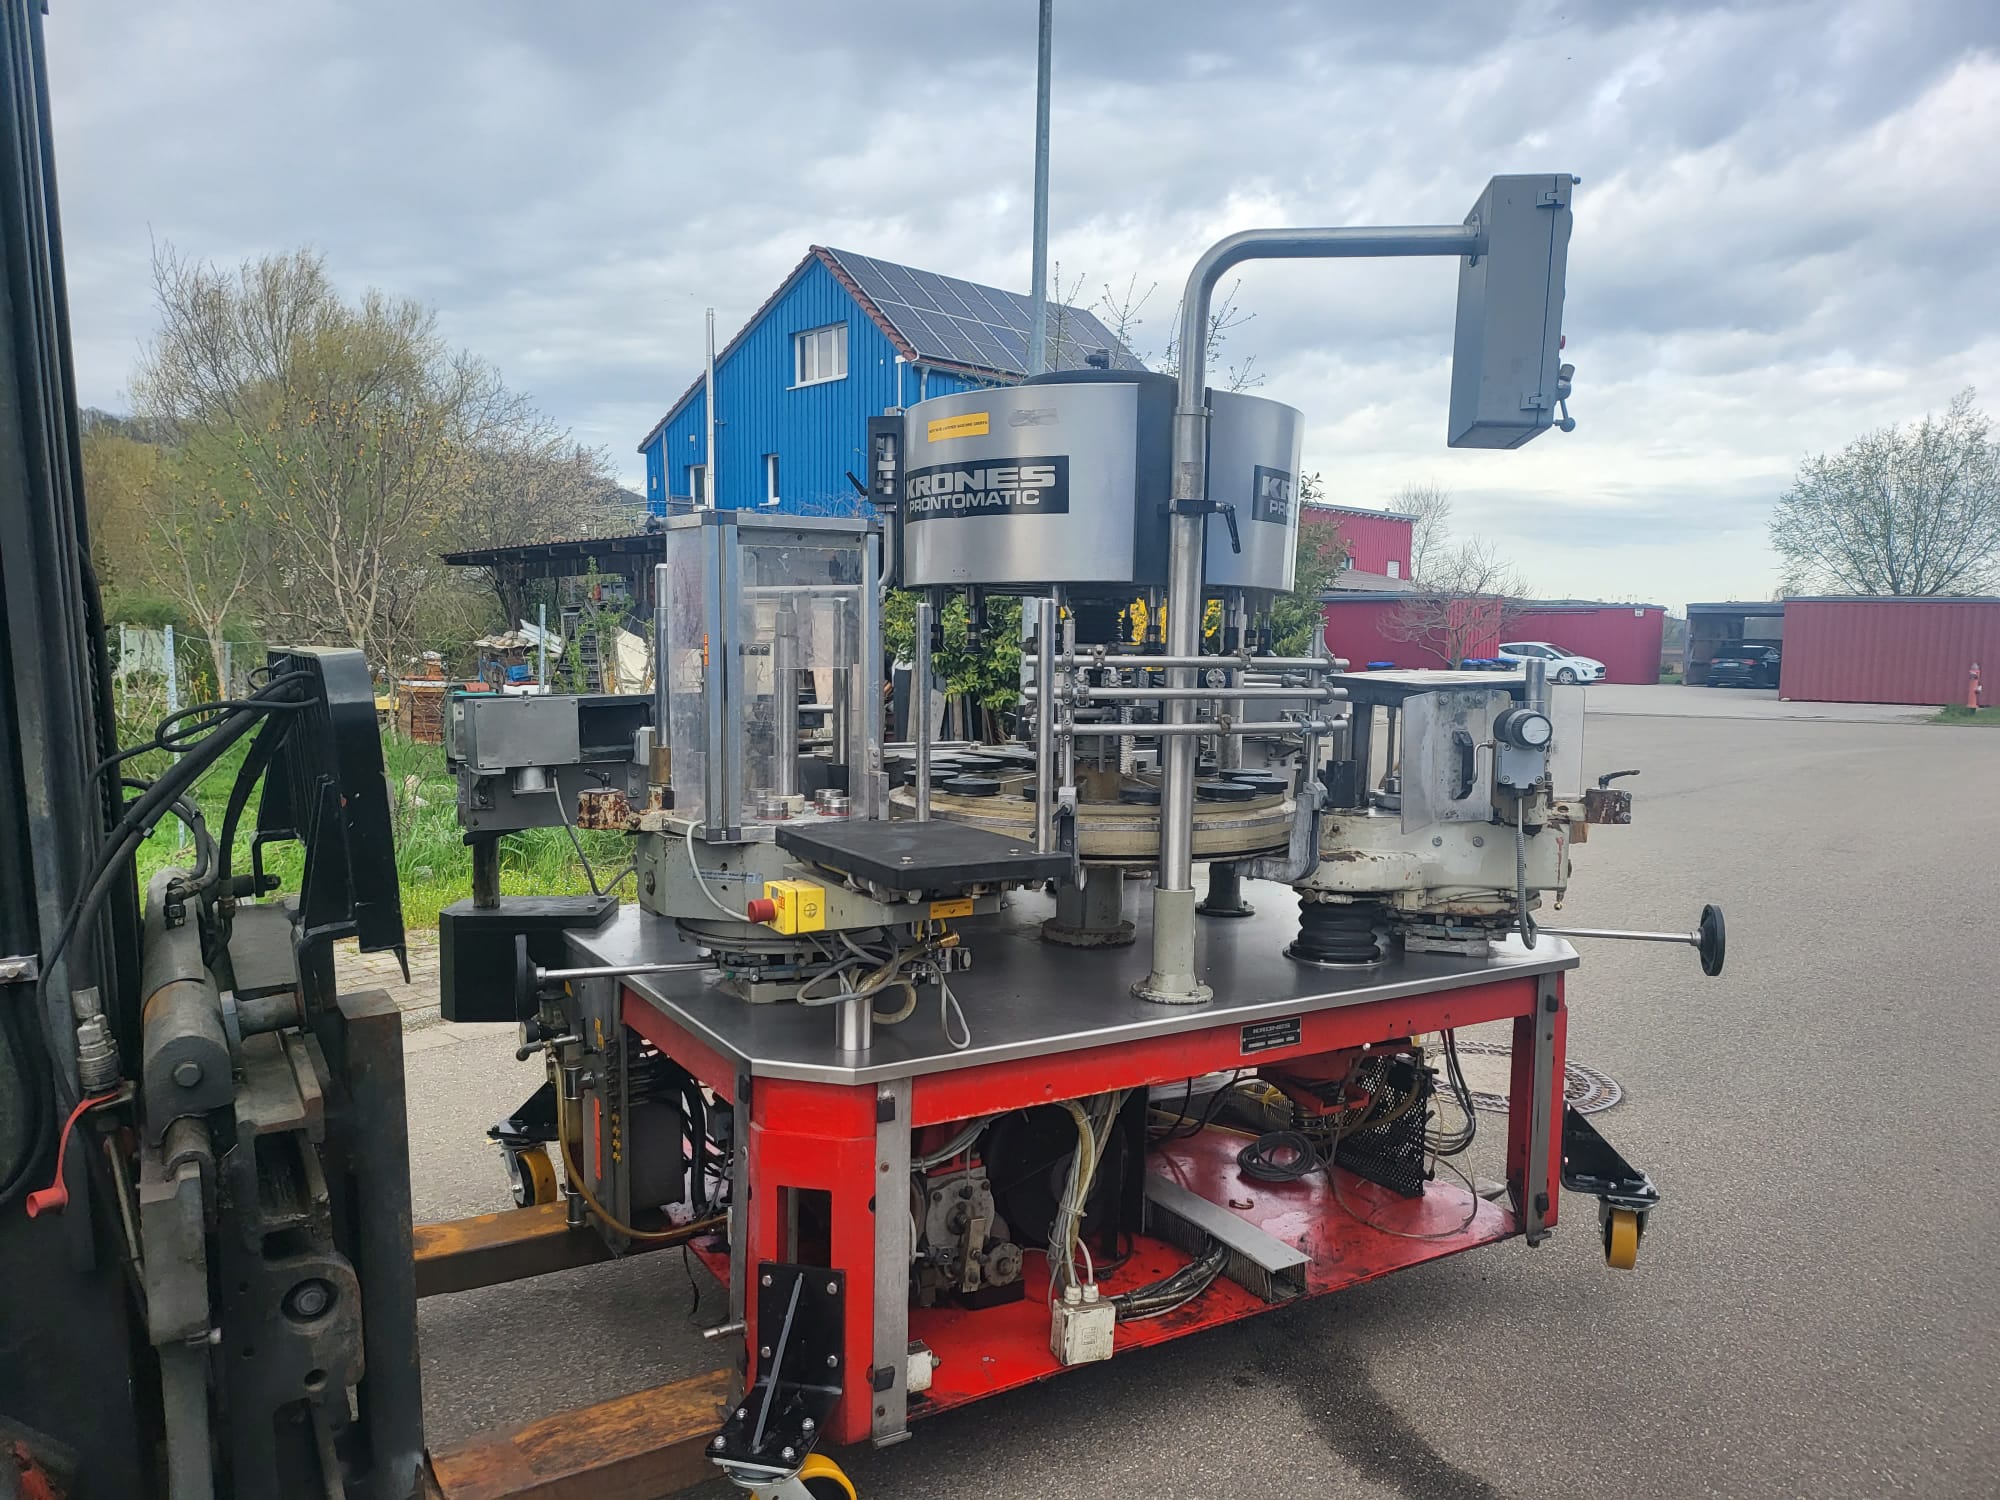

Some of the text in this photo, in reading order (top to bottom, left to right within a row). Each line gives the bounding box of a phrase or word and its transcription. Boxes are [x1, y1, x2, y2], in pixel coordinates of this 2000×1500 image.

[906, 465, 1056, 500] KRONES
[909, 490, 1040, 514] PRONTOMATIC
[1252, 1023, 1291, 1034] KRONES
